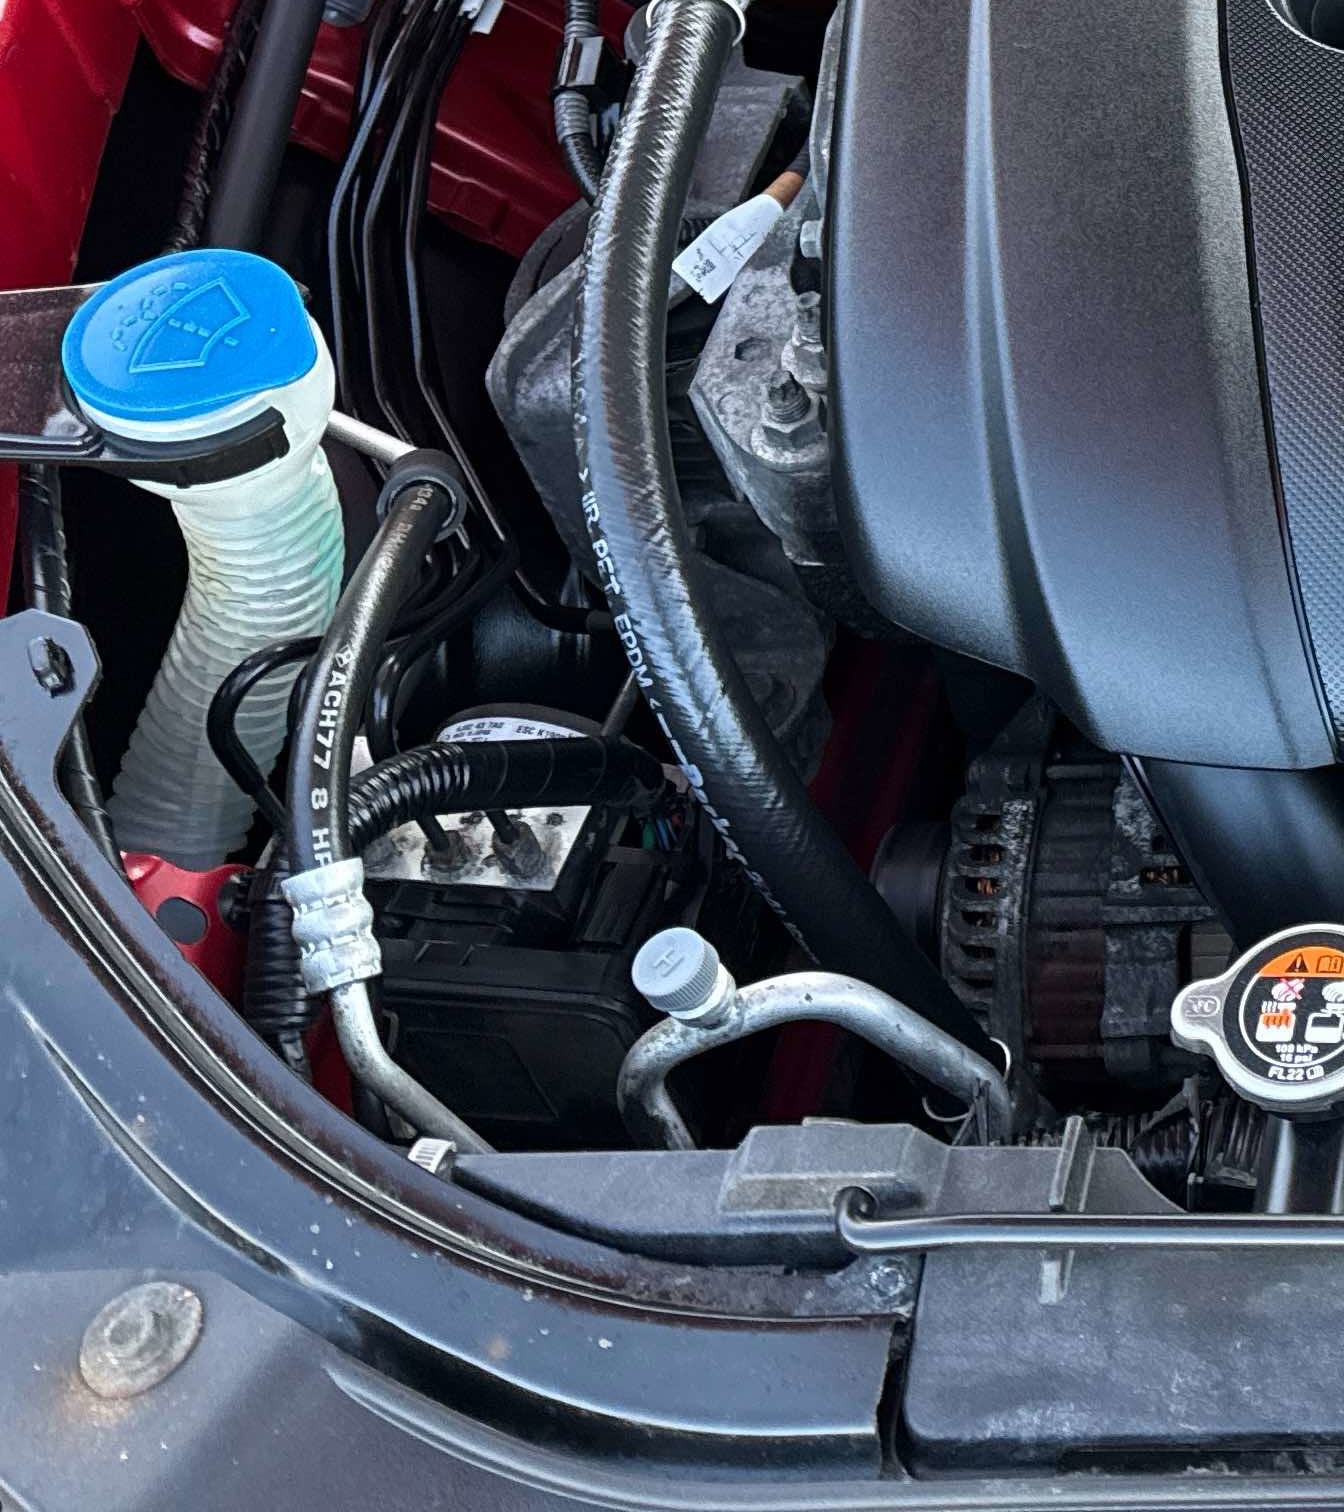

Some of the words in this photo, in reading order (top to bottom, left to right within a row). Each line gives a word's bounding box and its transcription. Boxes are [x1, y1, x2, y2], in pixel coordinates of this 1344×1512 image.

[591, 539, 622, 595] PET
[613, 613, 654, 691] EPDM
[314, 670, 346, 769] ACH77
[515, 725, 536, 736] ESC
[311, 787, 329, 810] 8
[1296, 1043, 1319, 1054] kPa
[1280, 1053, 1293, 1062] 16
[1294, 1054, 1313, 1064] psi
[1268, 1066, 1305, 1081] FL22
